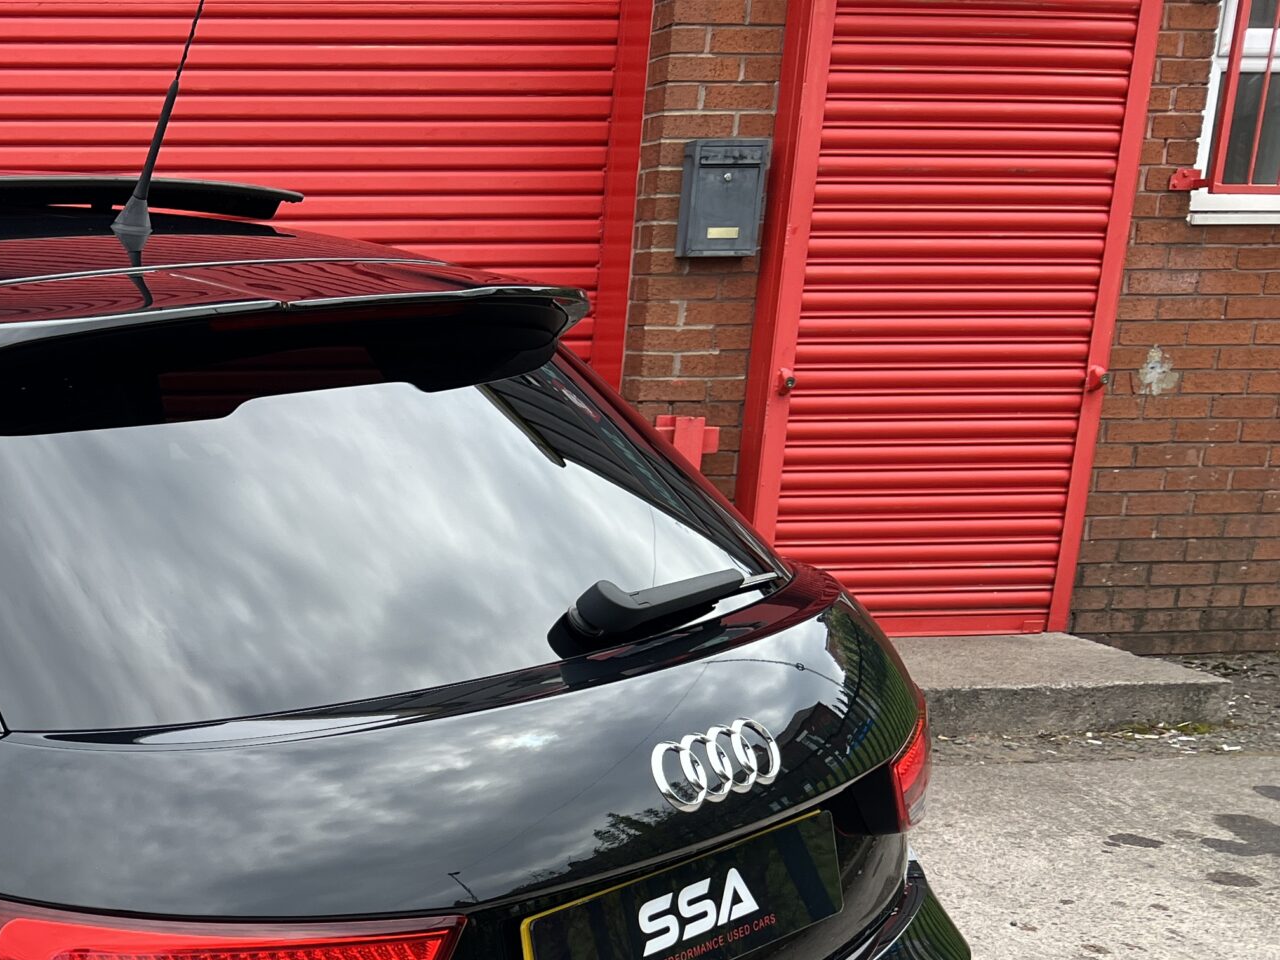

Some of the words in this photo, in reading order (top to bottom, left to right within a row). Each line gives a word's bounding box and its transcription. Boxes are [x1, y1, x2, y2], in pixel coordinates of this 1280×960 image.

[638, 867, 760, 958] SSA
[727, 924, 751, 943] USED
[752, 913, 777, 931] CARS
